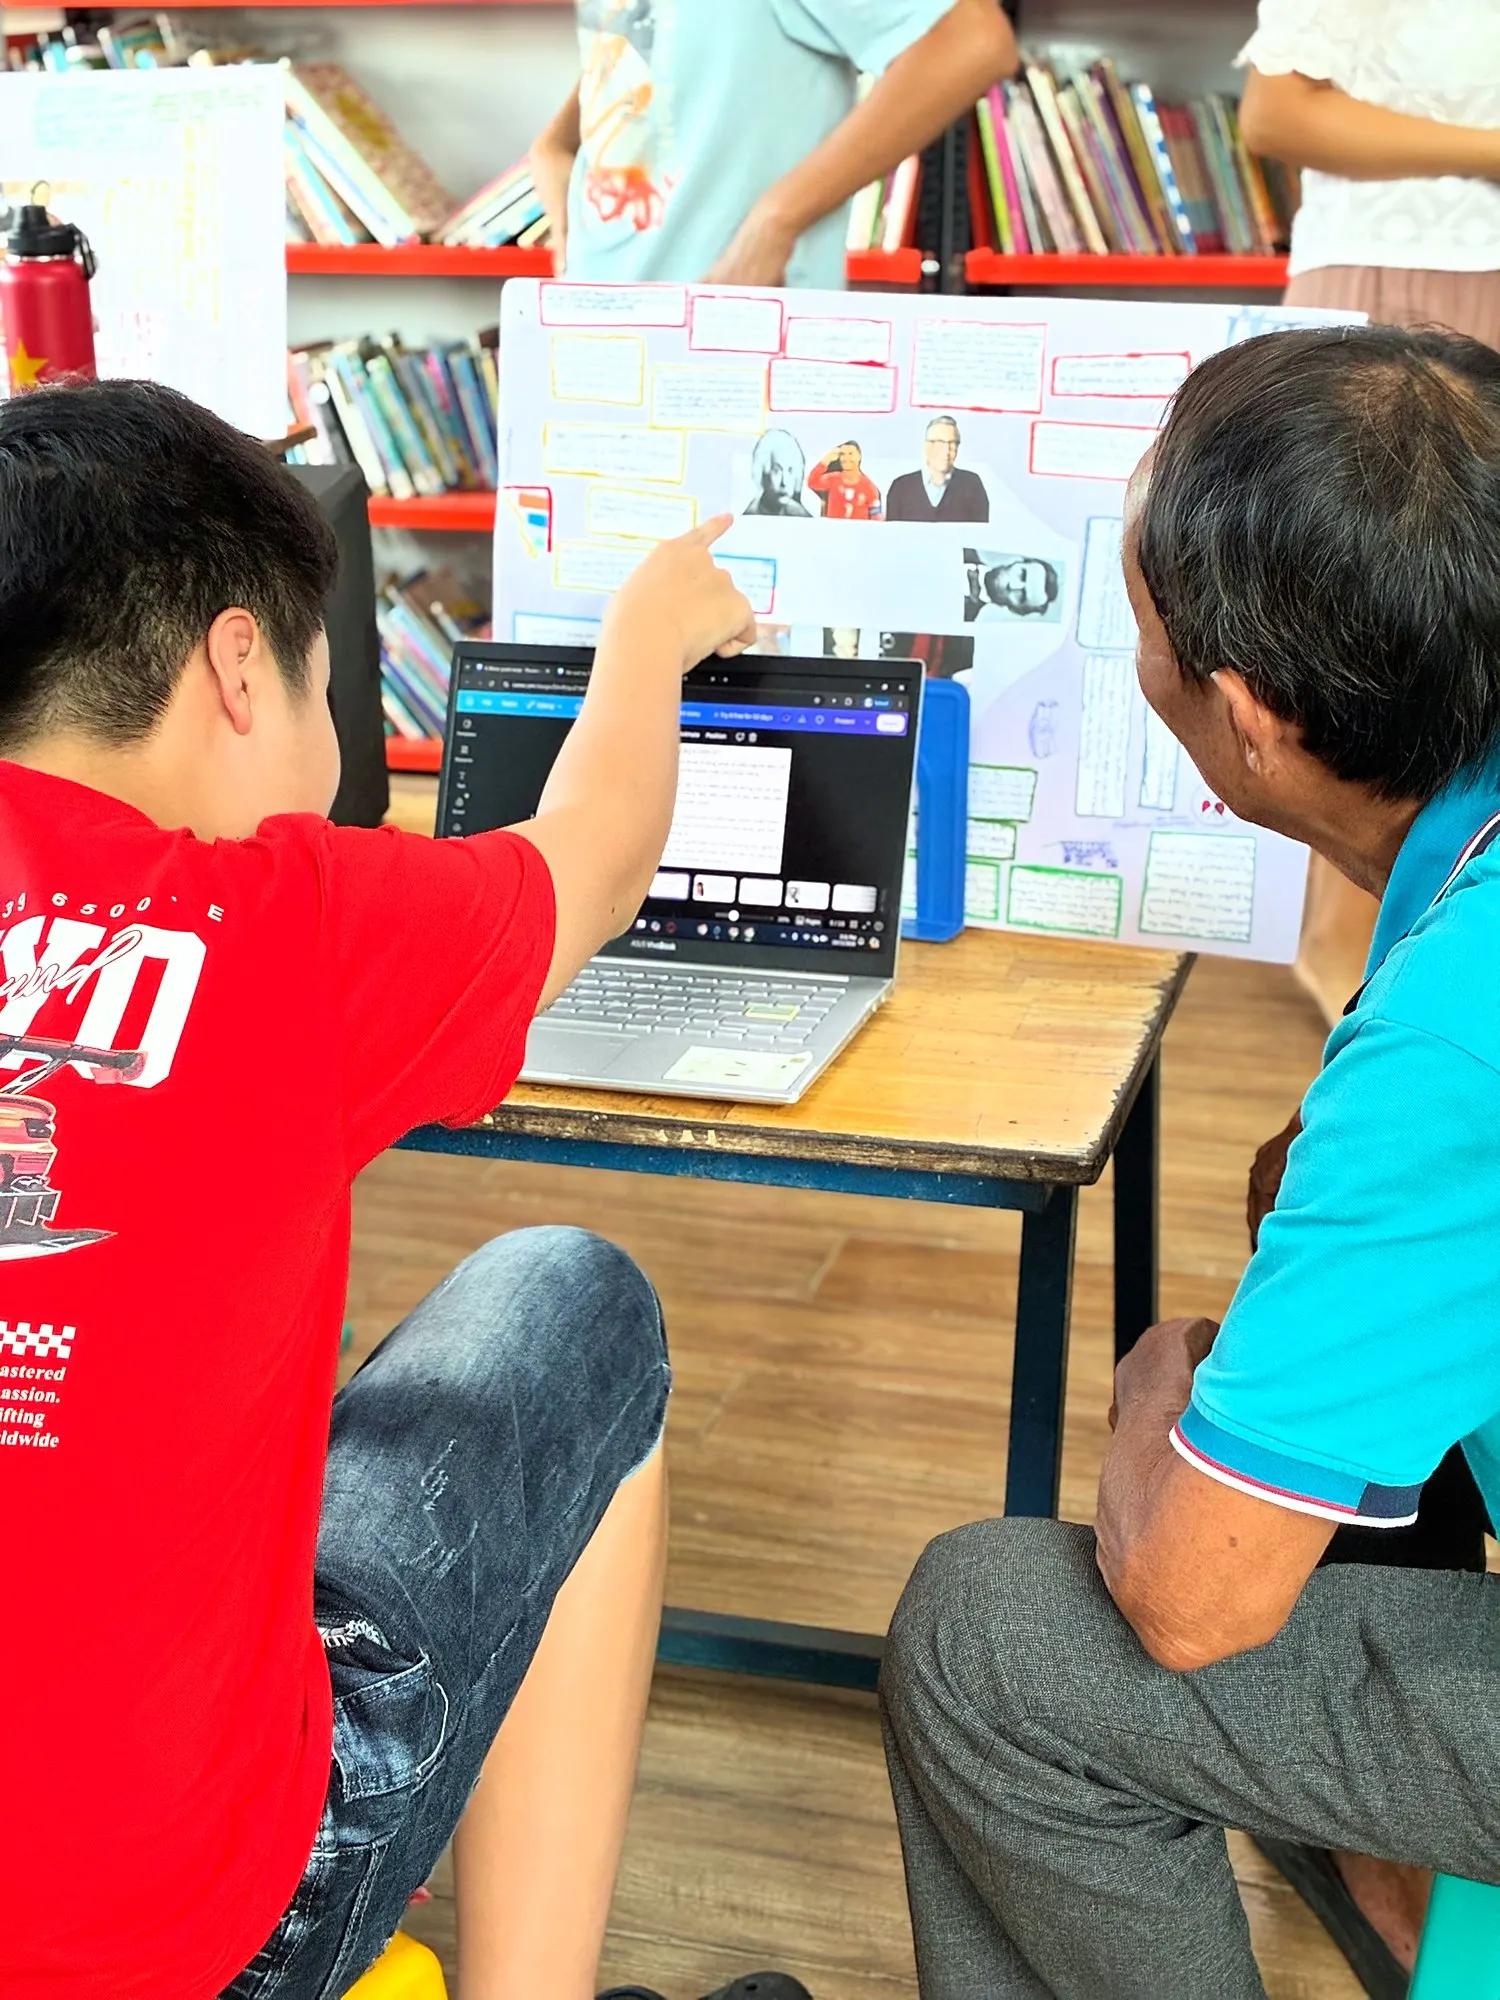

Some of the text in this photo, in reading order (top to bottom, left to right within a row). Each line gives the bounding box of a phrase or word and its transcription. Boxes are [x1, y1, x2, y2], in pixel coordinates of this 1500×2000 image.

[0, 915, 207, 1089] YO
[0, 1365, 67, 1381] astered
[0, 1386, 61, 1404] assion.
[0, 1429, 60, 1448] ldwide
